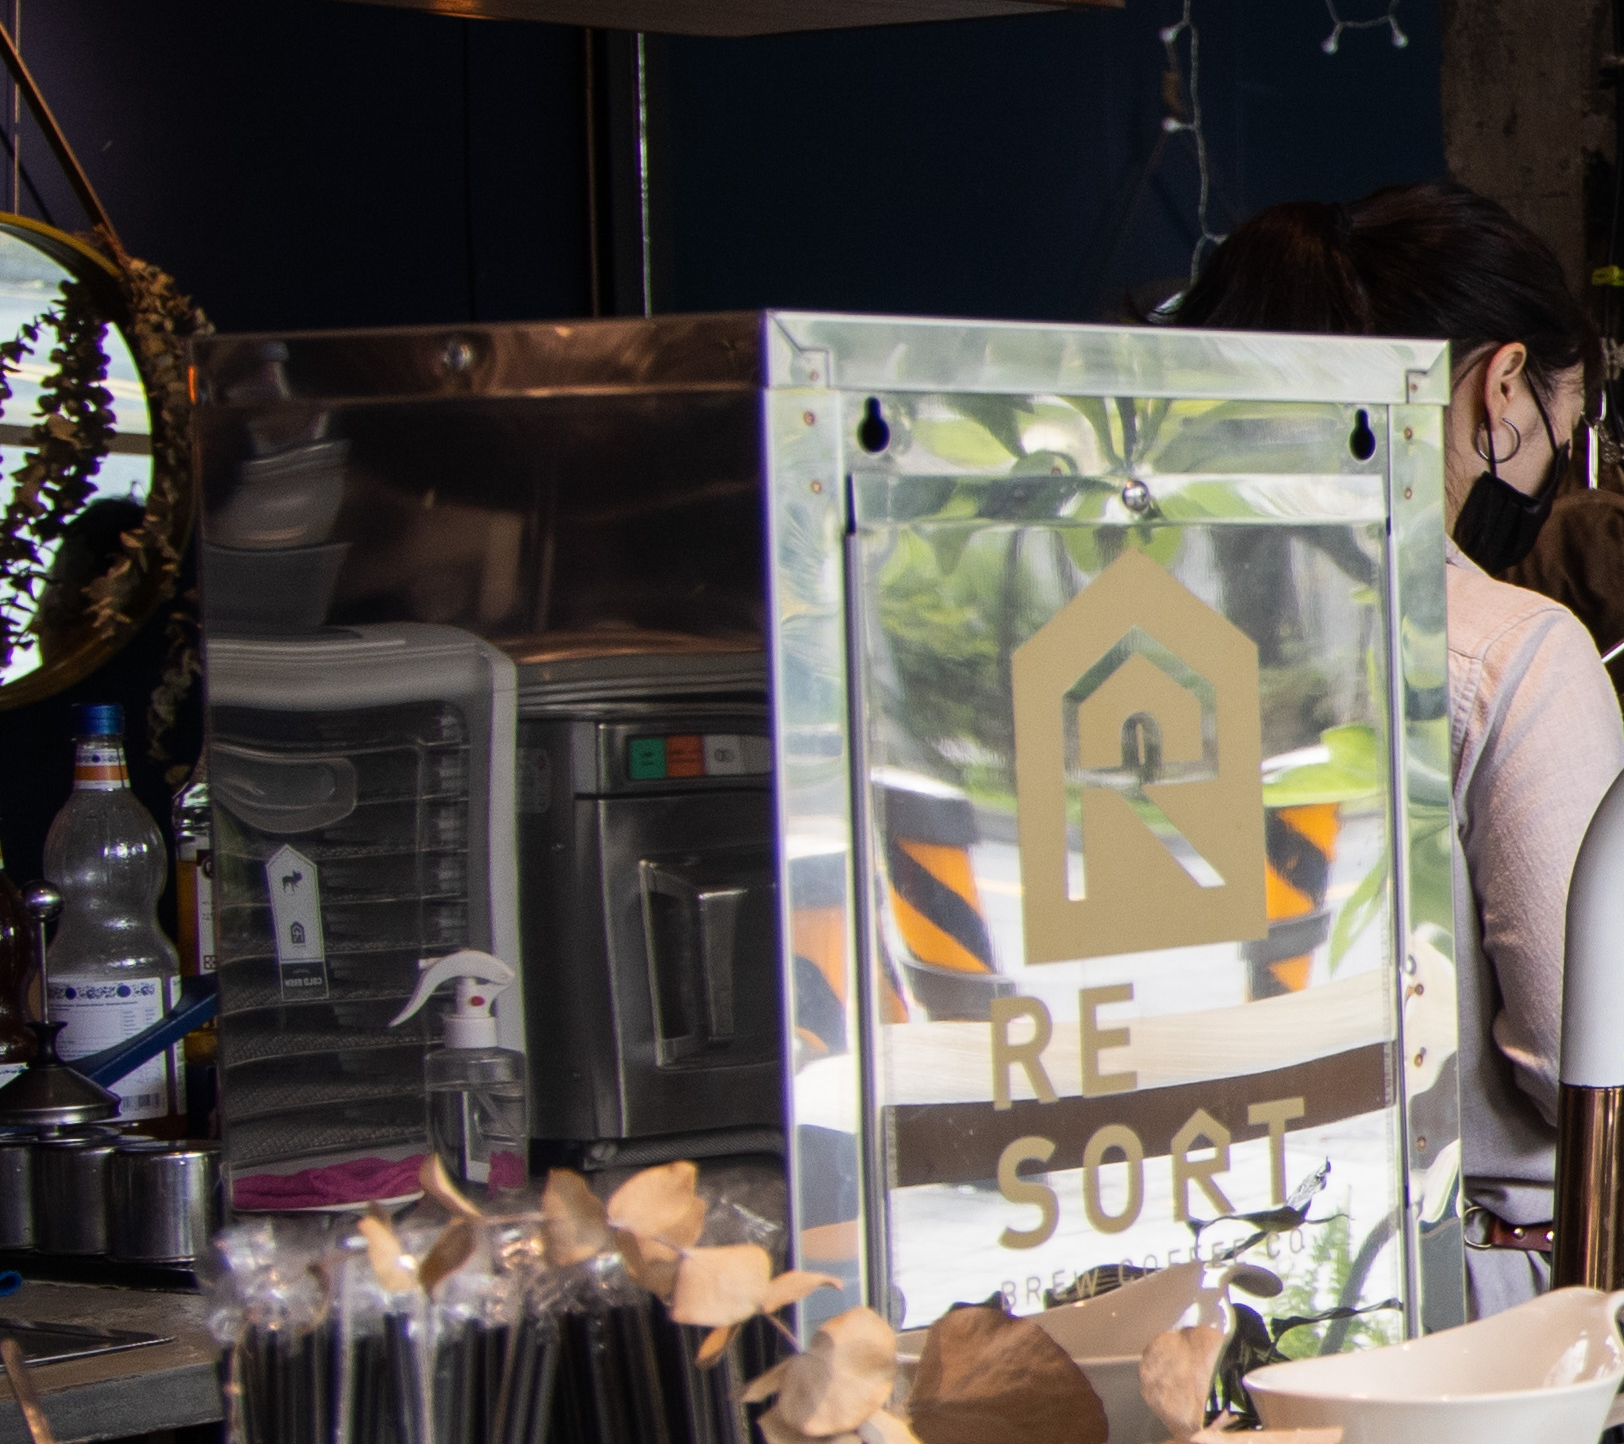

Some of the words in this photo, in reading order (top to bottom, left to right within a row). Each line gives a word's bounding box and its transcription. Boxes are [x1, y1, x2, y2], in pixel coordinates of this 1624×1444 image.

[990, 982, 1139, 1111] RE
[997, 1096, 1306, 1250] SORT
[1001, 1268, 1099, 1308] BREW
